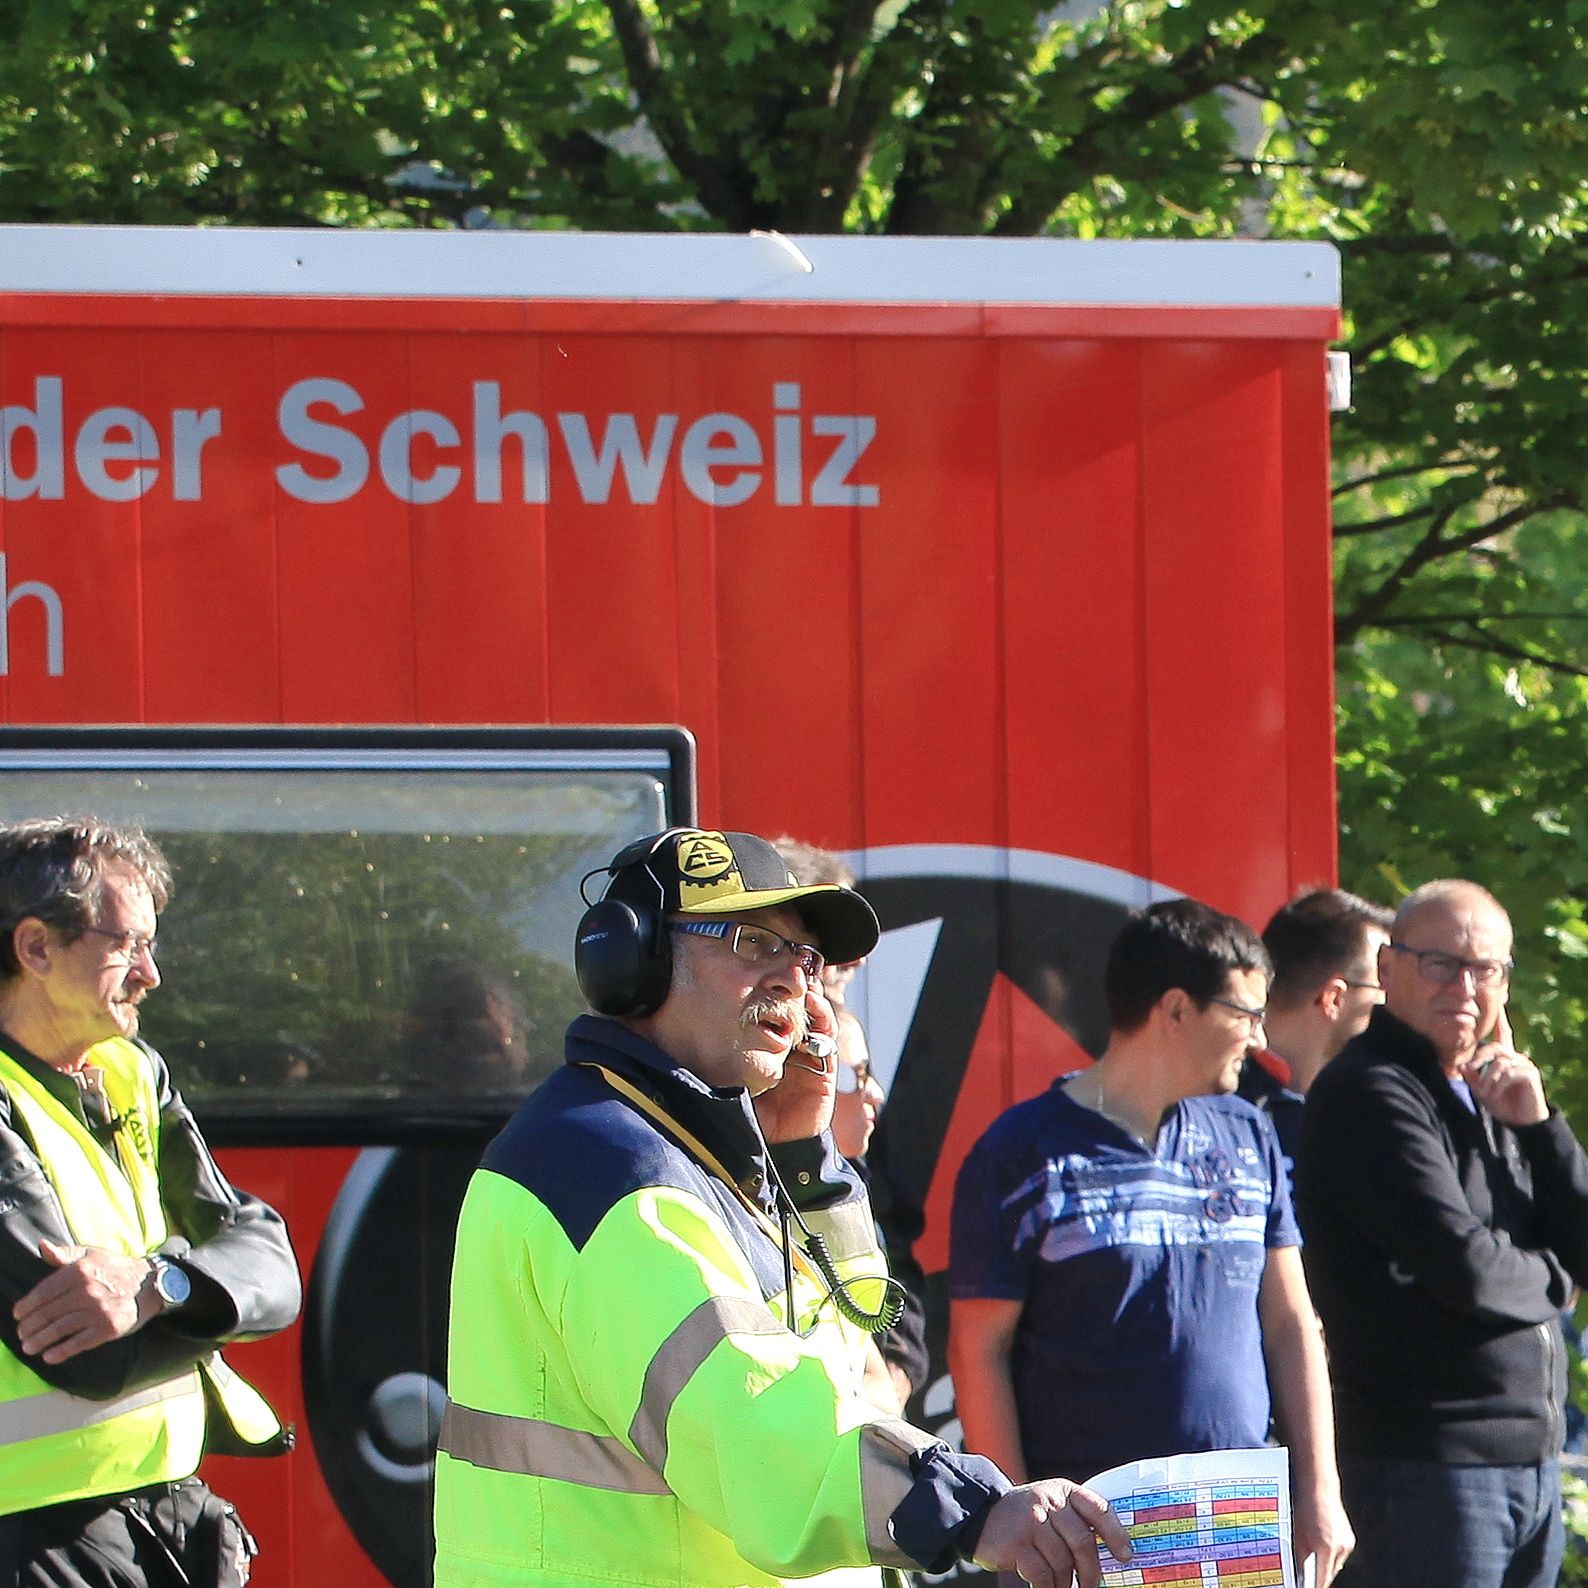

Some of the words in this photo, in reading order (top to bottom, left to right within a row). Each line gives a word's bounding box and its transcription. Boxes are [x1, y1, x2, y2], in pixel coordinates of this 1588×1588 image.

[0, 375, 222, 502] der
[276, 377, 880, 507] Schweiz
[684, 841, 729, 872] ACS
